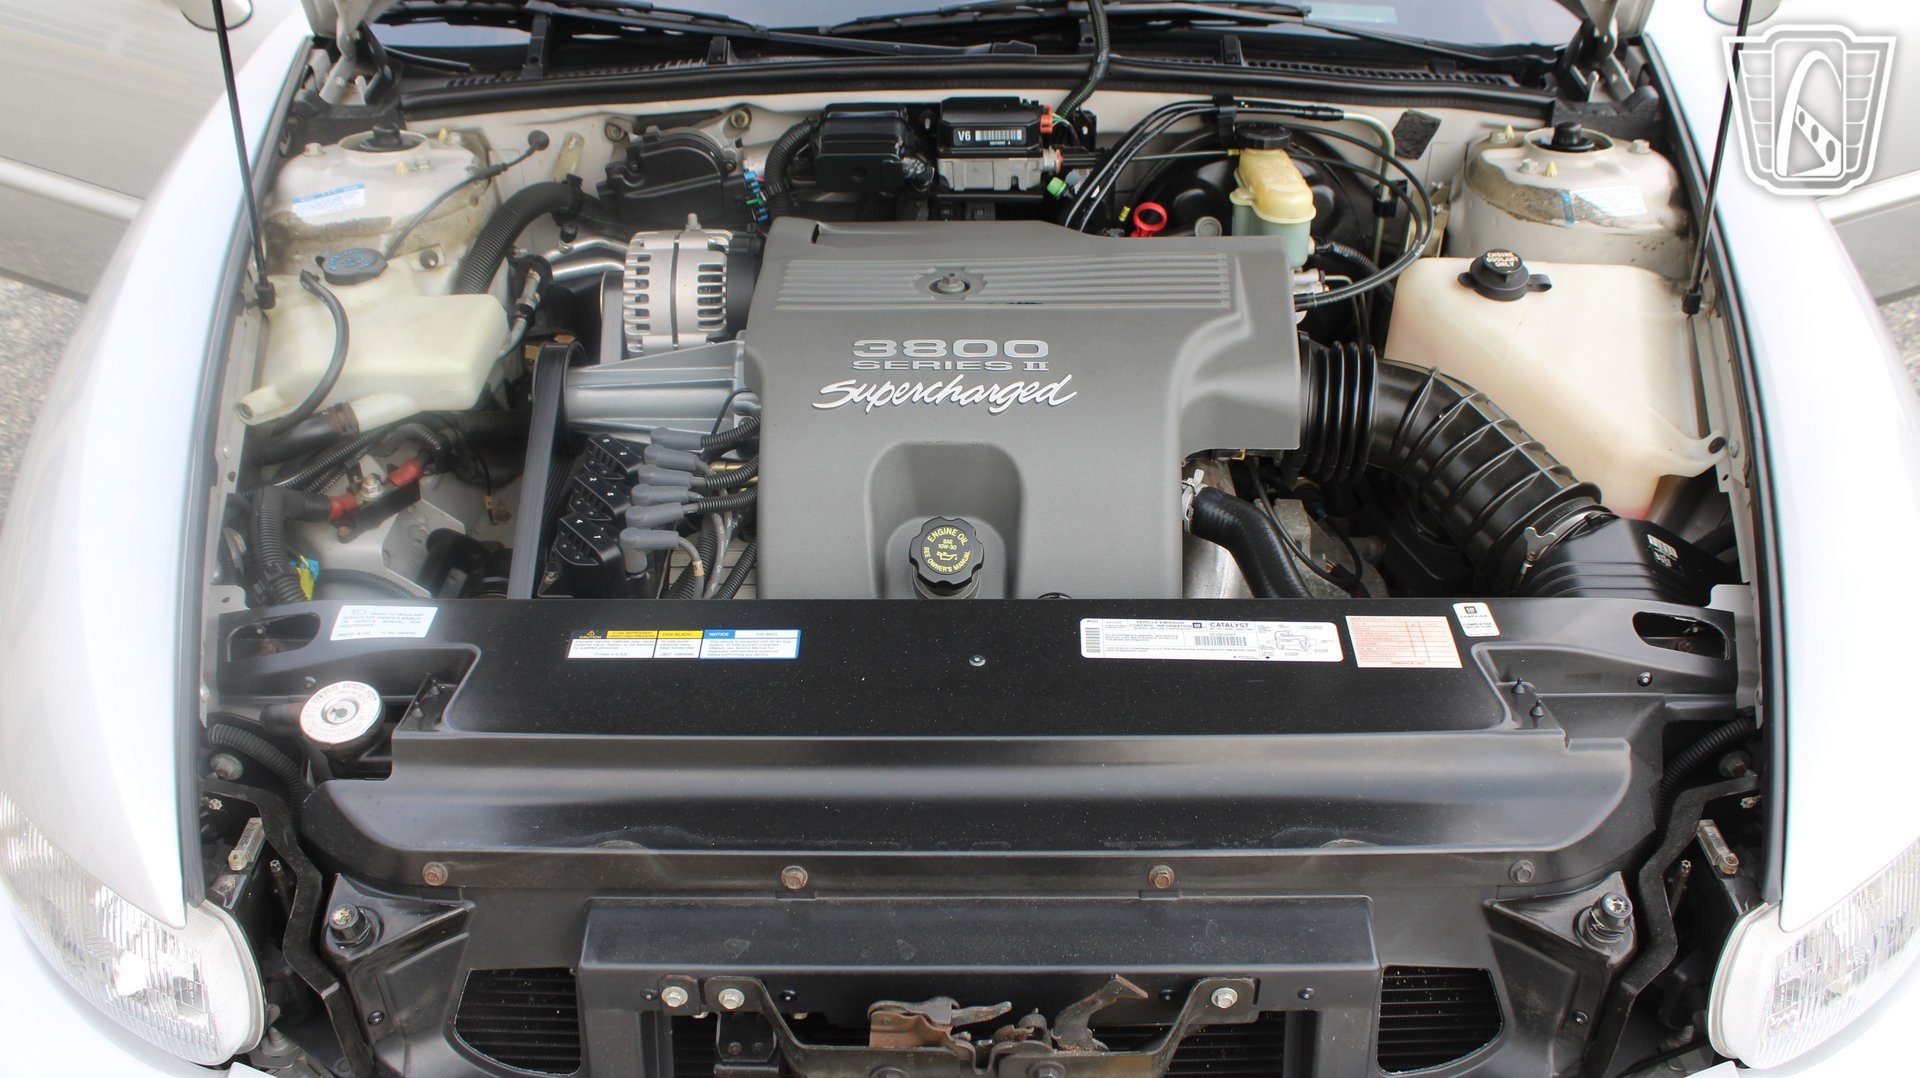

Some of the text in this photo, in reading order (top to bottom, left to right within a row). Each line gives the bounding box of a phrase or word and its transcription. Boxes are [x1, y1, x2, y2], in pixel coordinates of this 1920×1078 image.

[958, 130, 971, 141] V6
[853, 339, 1049, 358] 3800
[852, 360, 1050, 371] SERIES II
[812, 374, 1077, 414] Supercharged
[927, 528, 969, 546] ENGINE OIL
[923, 546, 970, 572] SEE OWNER'S MANUAL
